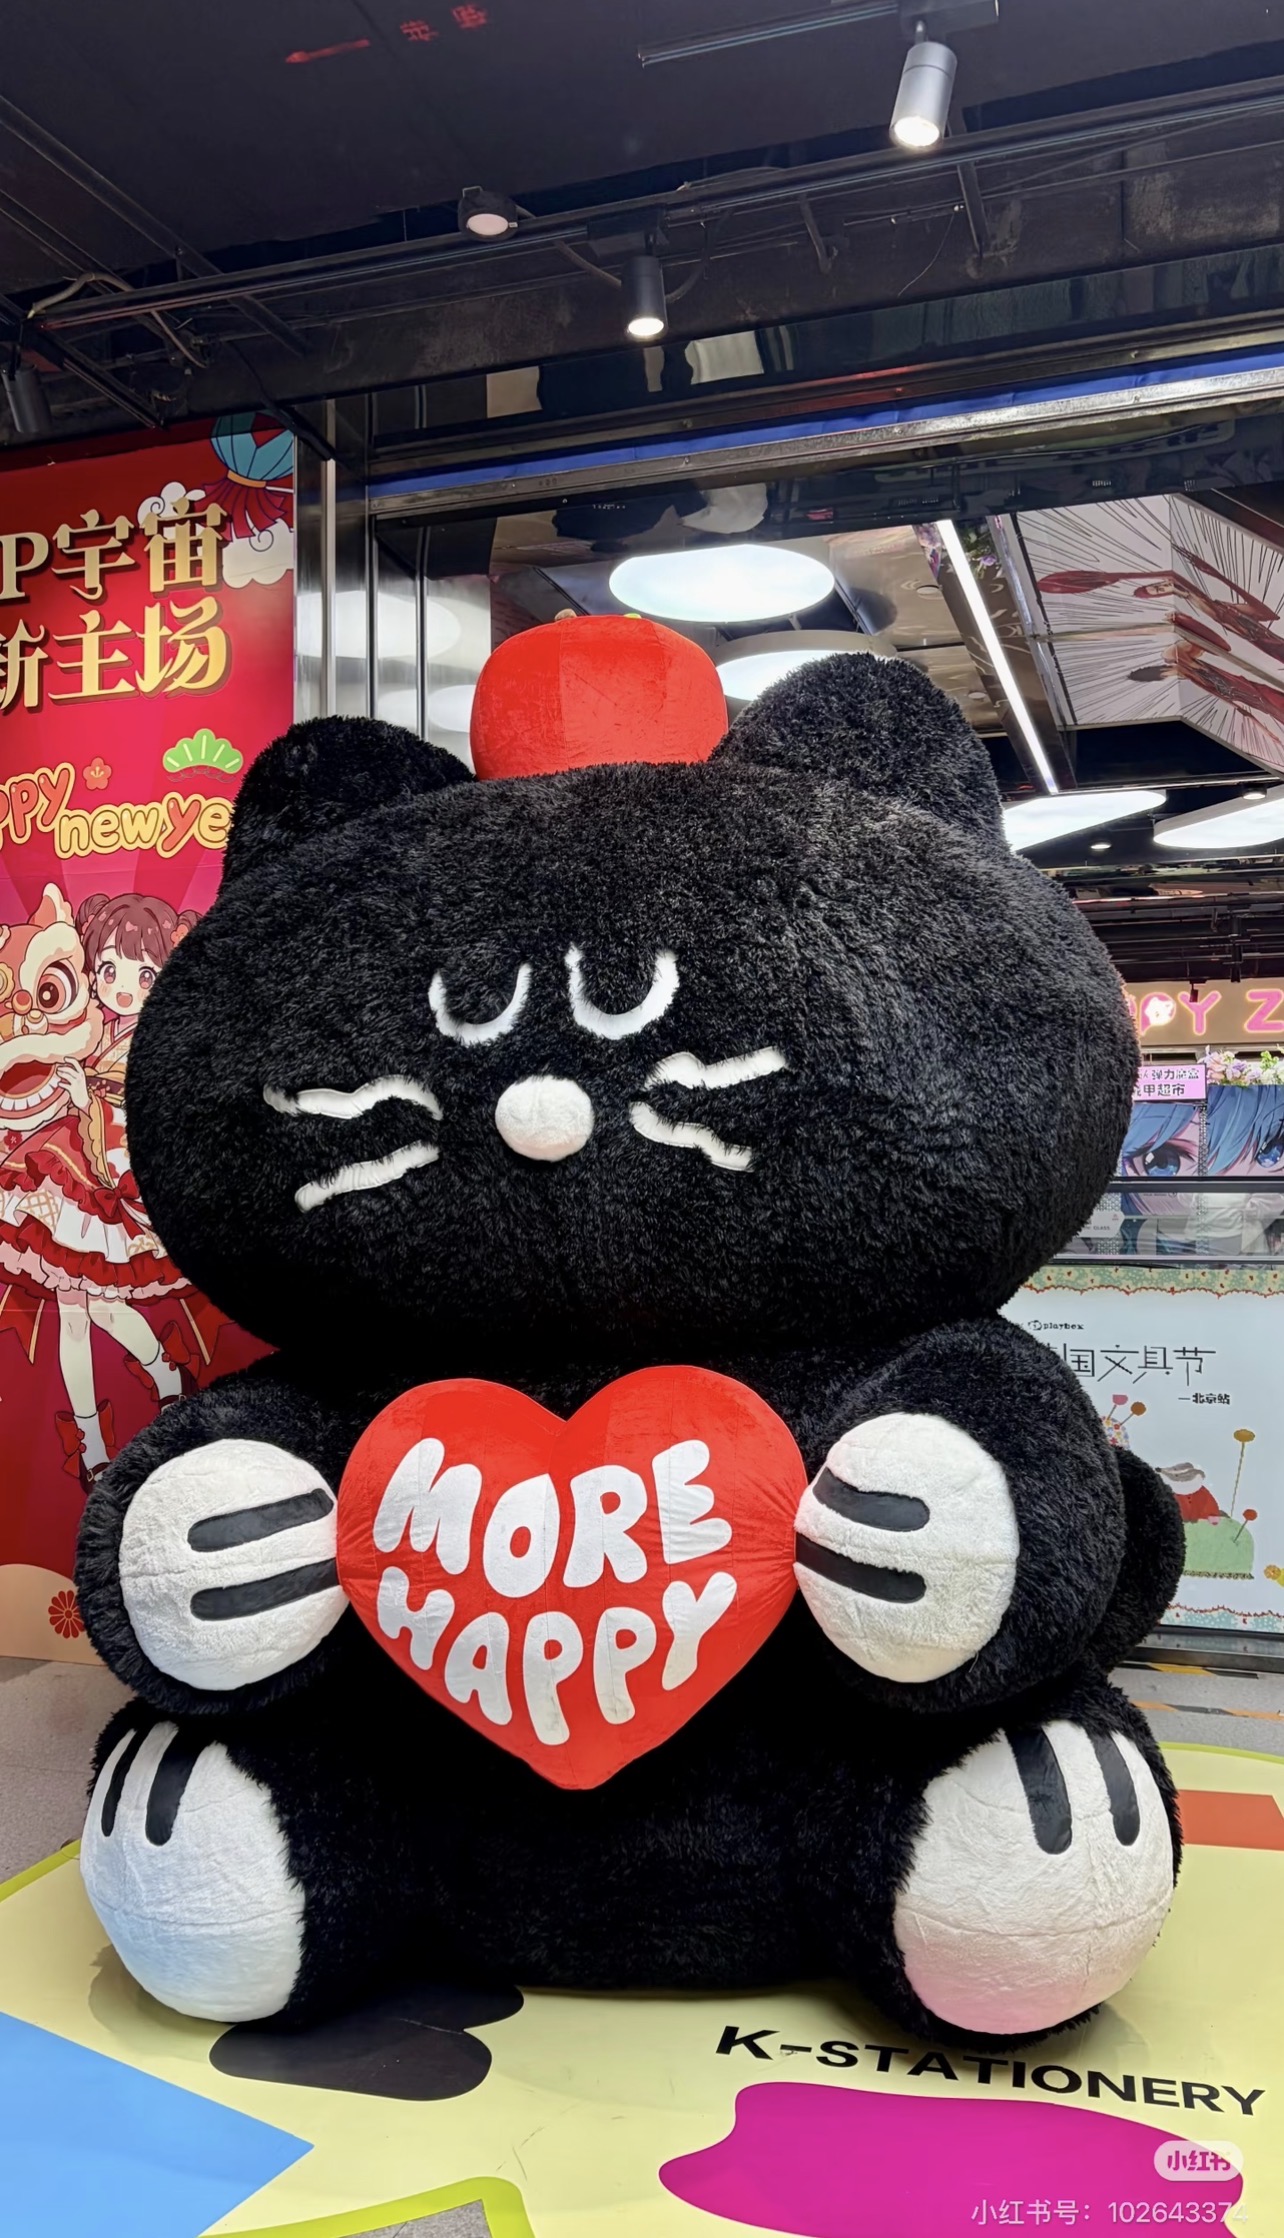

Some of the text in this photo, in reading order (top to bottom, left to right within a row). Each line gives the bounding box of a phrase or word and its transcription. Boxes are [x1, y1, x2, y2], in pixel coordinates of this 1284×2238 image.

[0, 595, 230, 710] 新主场
[373, 1437, 733, 1598] MORE
[376, 1565, 738, 1746] HAPPY
[715, 2025, 1266, 2116] K-STATIONERY
